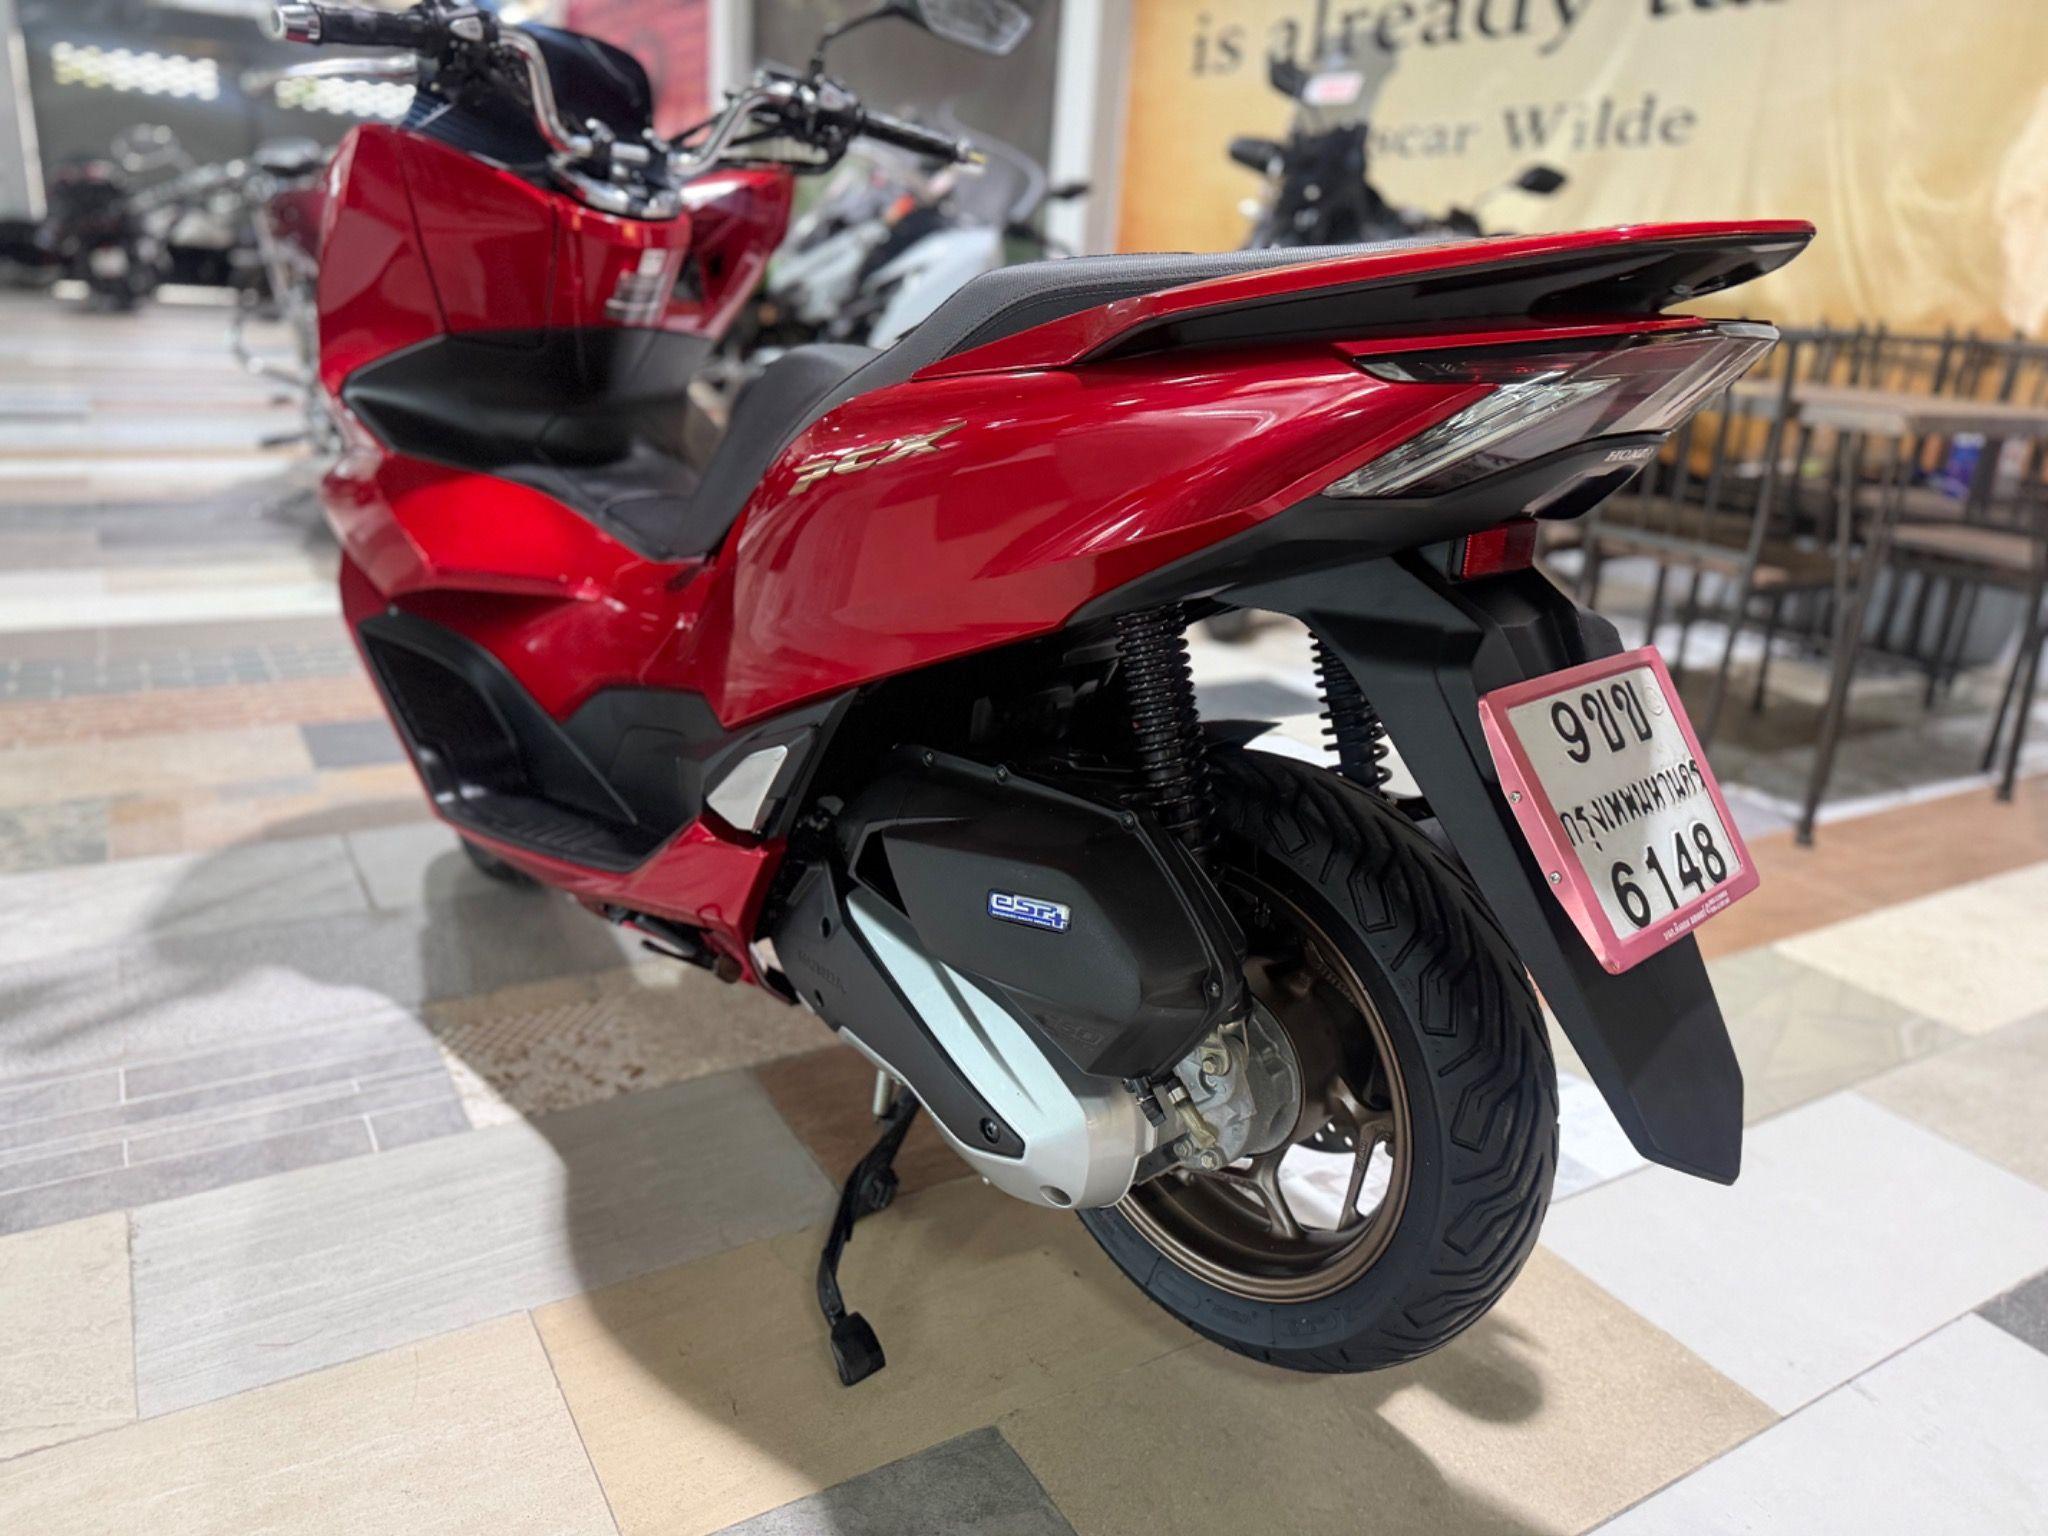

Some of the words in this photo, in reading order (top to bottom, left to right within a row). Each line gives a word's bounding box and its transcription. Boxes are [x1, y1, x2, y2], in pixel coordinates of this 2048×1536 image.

[1191, 13, 1244, 77] is
[1368, 120, 1482, 159] scar
[1503, 95, 1697, 152] Wilde
[788, 421, 967, 495] PCX
[1551, 681, 1652, 763] 9ขข
[1560, 760, 1707, 852] กรุงเทพมหานคร
[1611, 823, 1727, 928] 6148
